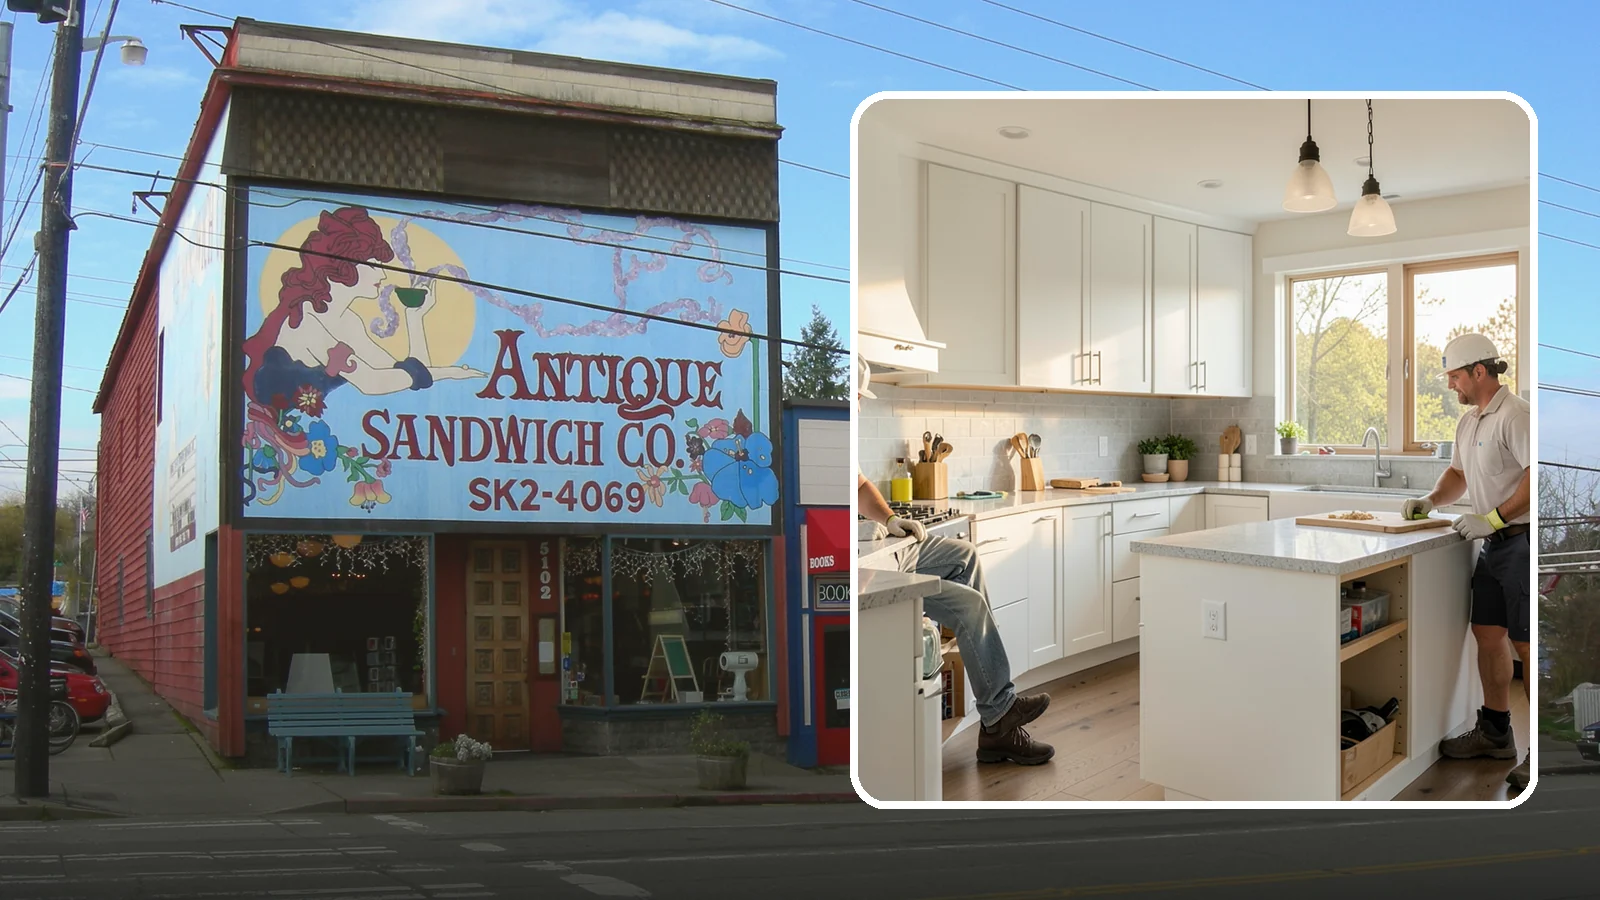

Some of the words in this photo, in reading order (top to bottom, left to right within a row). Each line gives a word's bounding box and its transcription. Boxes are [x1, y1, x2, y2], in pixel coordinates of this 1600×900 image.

[476, 329, 724, 421] ANTIQUE
[361, 409, 604, 467] SANDWICH
[617, 421, 685, 468] CO.
[468, 477, 646, 512] SK2-4069
[540, 541, 552, 600] 5102
[809, 555, 835, 569] BOOKS
